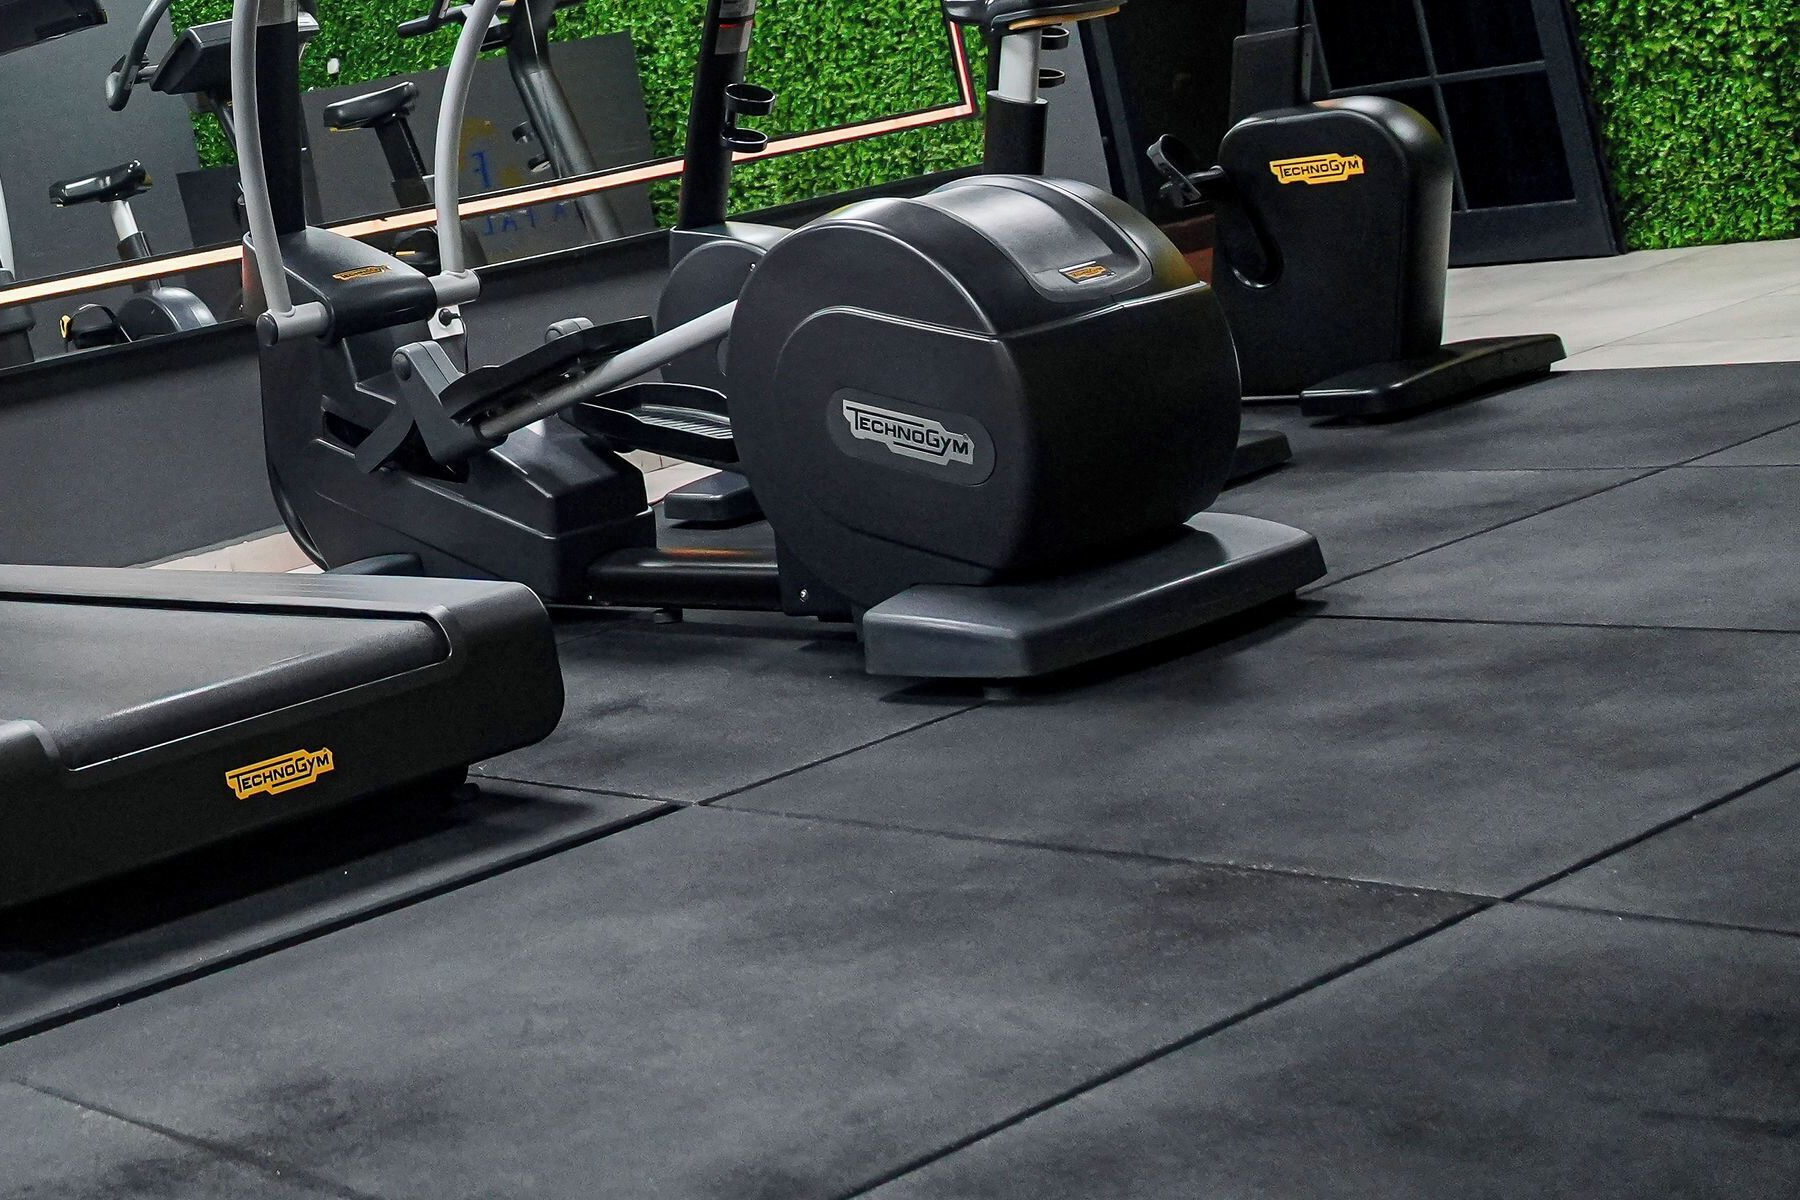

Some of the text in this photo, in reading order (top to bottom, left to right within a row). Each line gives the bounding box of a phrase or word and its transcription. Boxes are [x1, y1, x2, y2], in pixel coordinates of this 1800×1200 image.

[1273, 158, 1360, 179] TECHNOGYM
[845, 406, 969, 457] TECHNOGYM
[228, 753, 330, 793] TECHNOGYM
